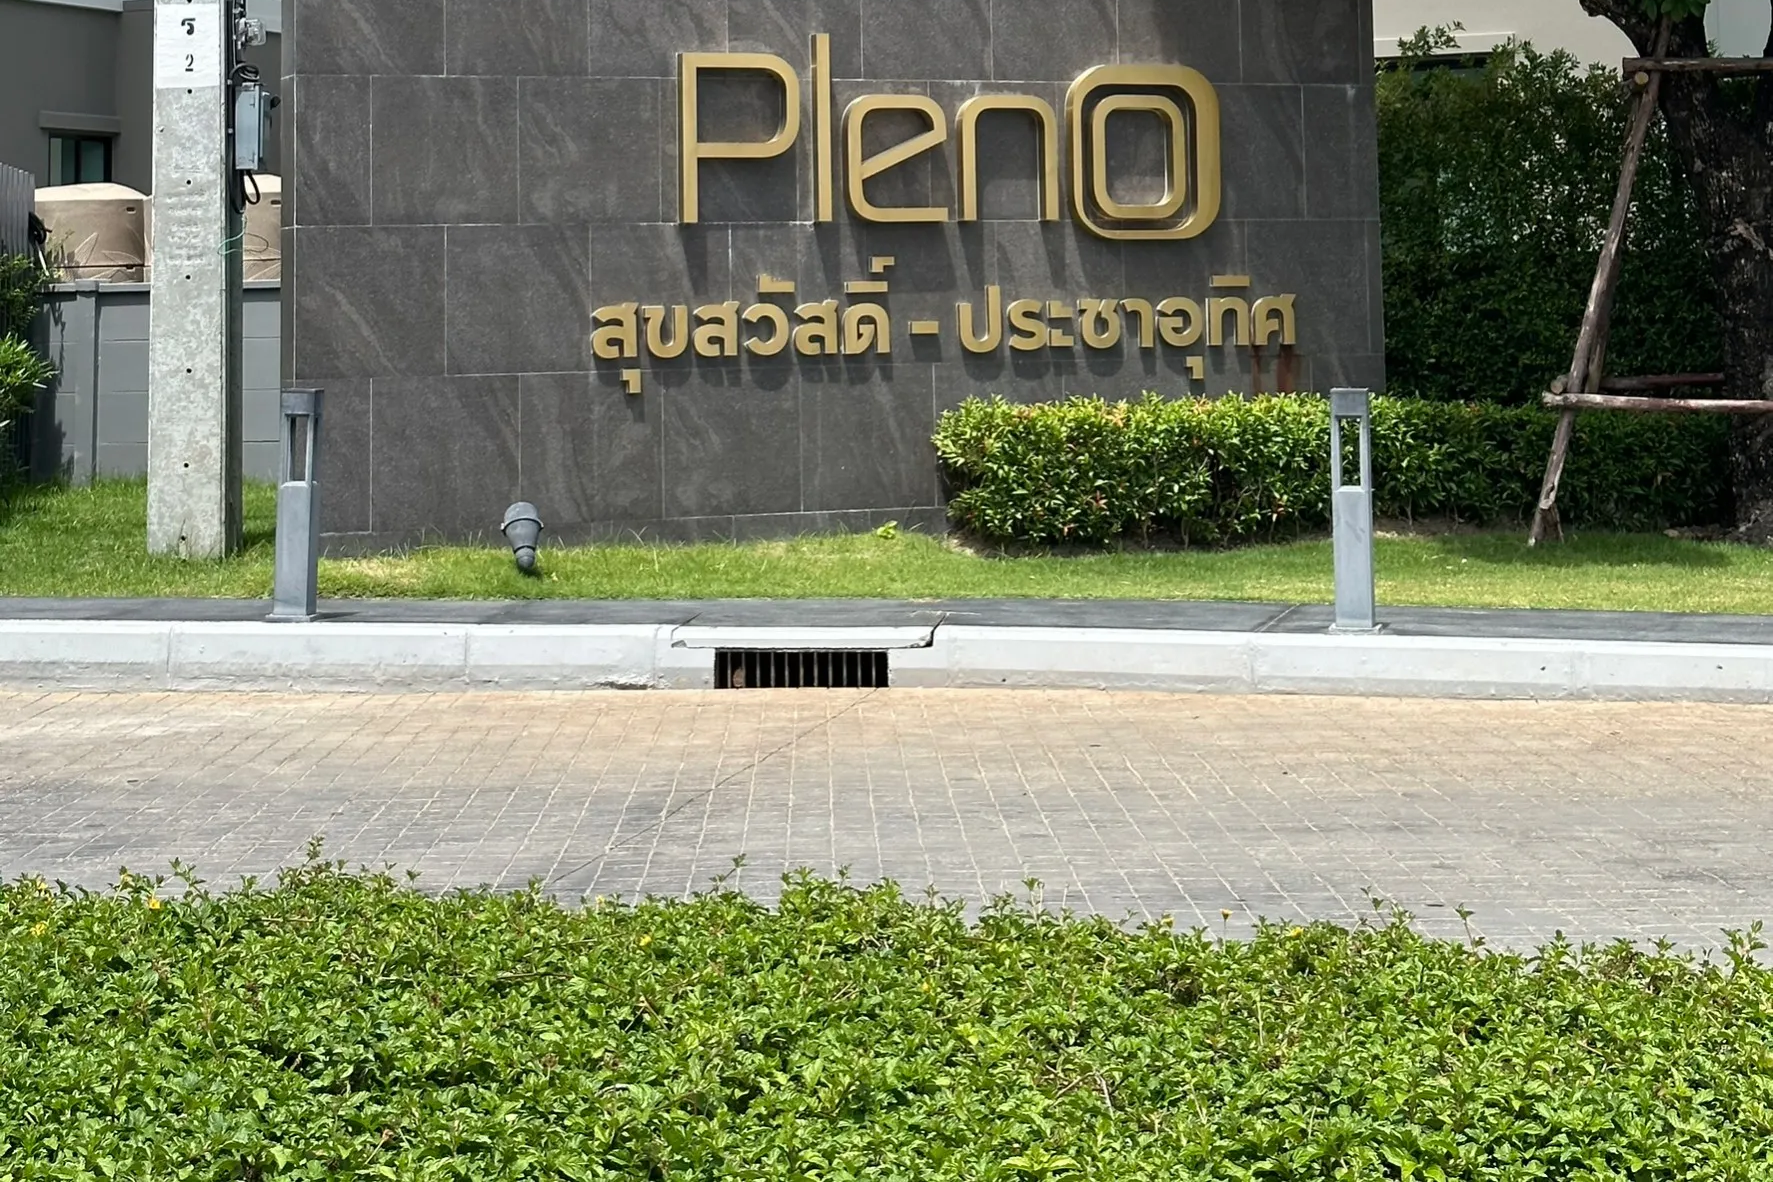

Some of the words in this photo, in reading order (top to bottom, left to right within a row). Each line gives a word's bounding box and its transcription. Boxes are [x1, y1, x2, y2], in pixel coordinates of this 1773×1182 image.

[185, 53, 194, 72] 2
[590, 256, 895, 394] สุขสวัสดิ์
[908, 320, 940, 335] -
[955, 274, 1297, 380] ประชาอุทิศ
